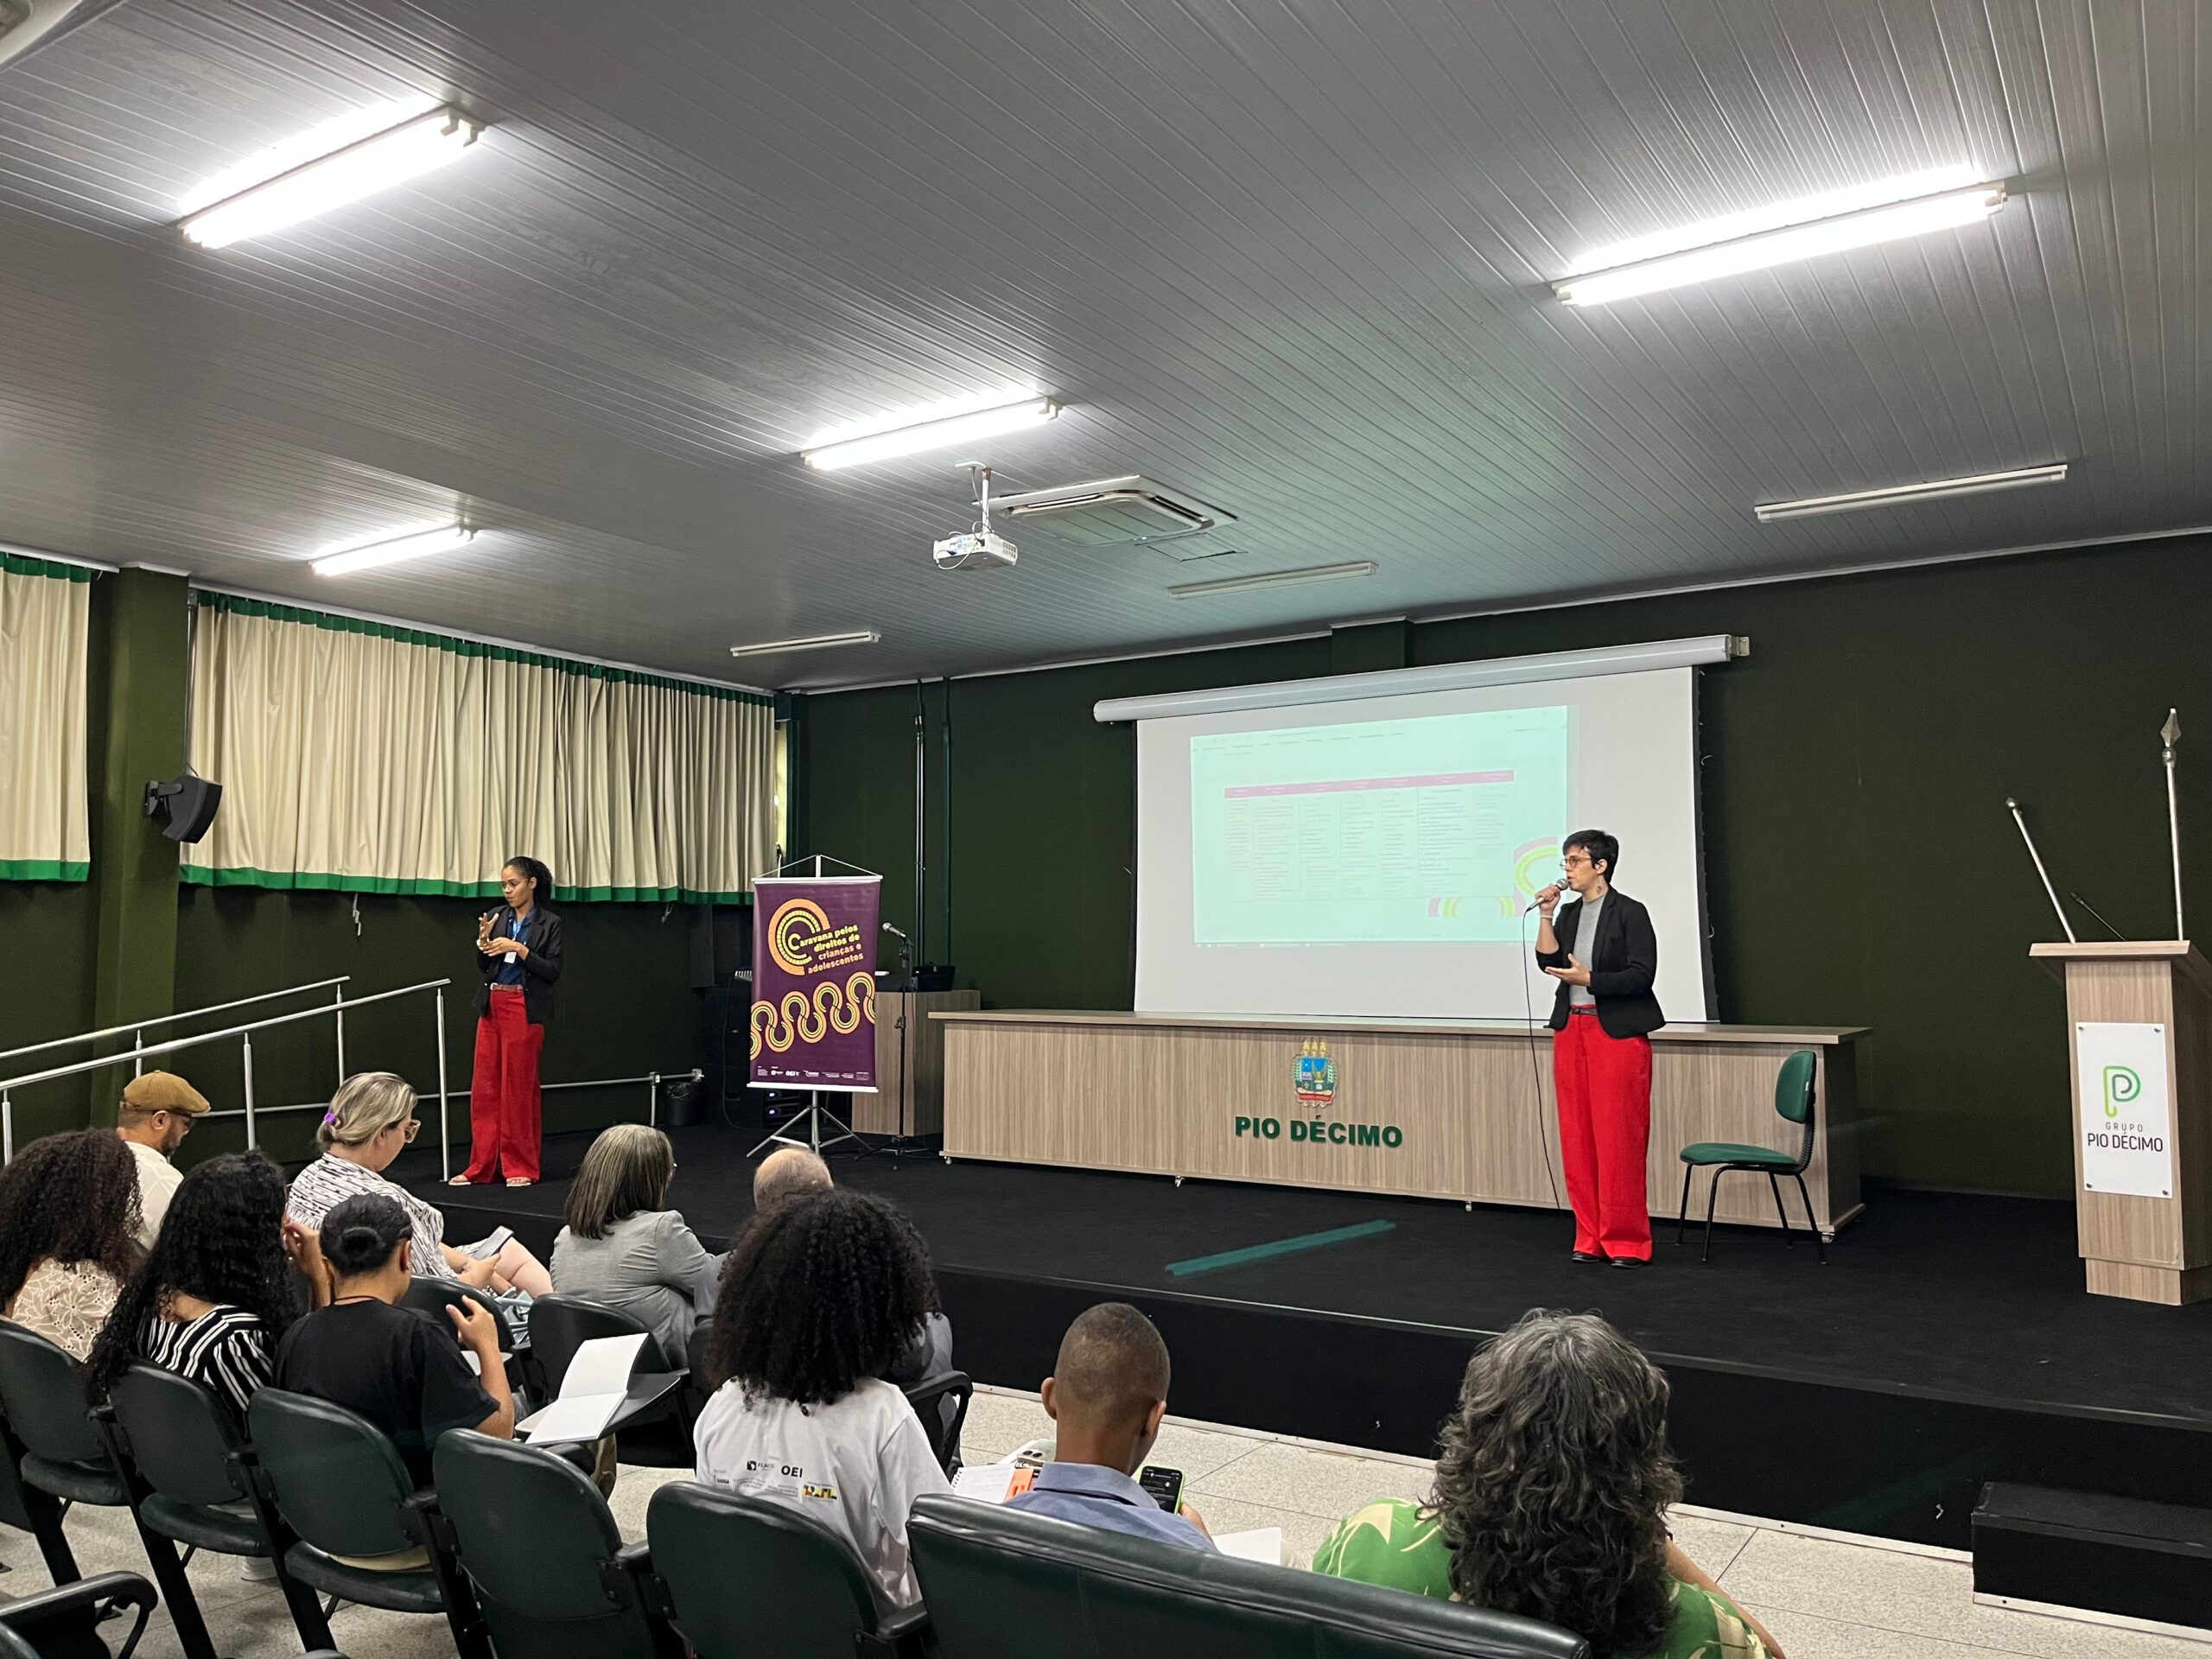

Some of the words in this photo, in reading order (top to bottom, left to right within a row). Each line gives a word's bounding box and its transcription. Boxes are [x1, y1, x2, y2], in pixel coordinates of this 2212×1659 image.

[788, 932, 834, 950] Caravana
[835, 925, 858, 938] pelos
[814, 938, 847, 952] direitos
[818, 945, 855, 960] crianças
[808, 953, 863, 974] adolescentes
[1235, 1116, 1281, 1140] PIO
[1290, 1114, 1403, 1148] DÉCIMO
[2106, 1122, 2143, 1132] GRUPO
[2088, 1133, 2108, 1147] PIO
[2112, 1131, 2164, 1153] DÉCIMO
[780, 1465, 804, 1478] OEI
